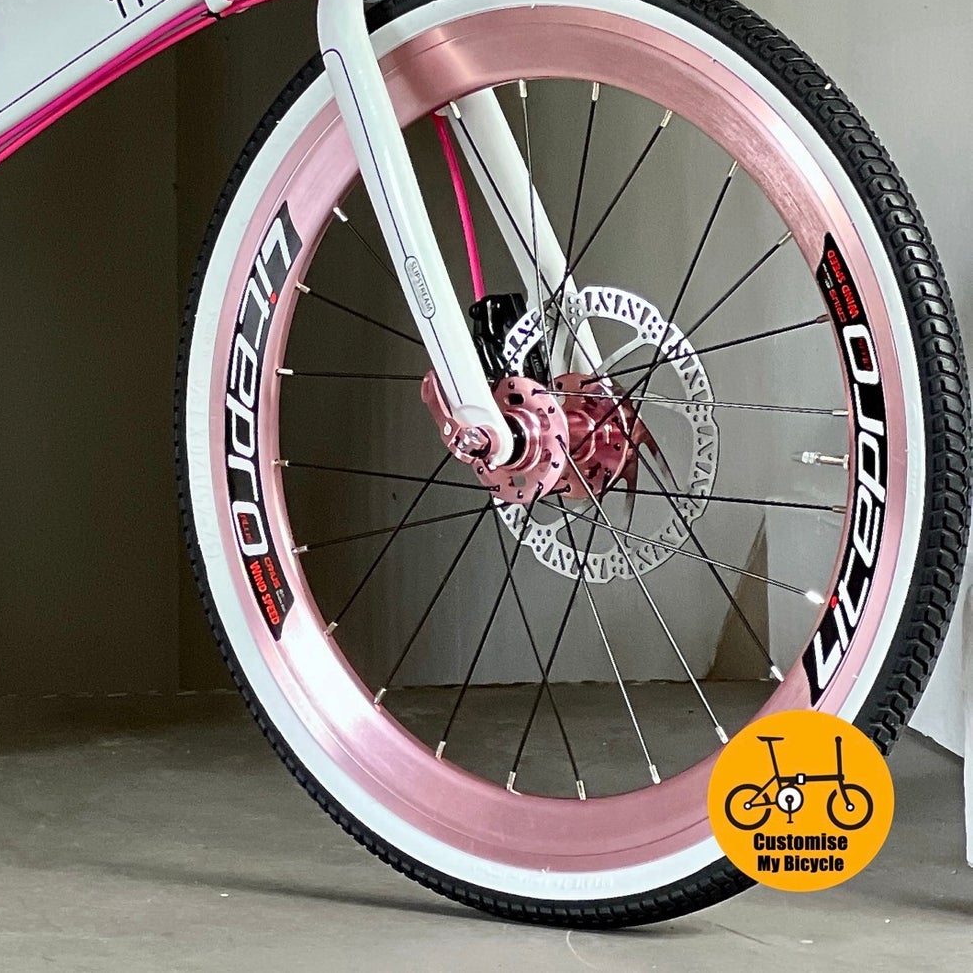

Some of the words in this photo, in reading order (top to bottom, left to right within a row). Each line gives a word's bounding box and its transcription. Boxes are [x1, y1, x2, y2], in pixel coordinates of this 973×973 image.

[410, 261, 433, 312] SLIPSTREAM
[827, 249, 846, 284] SPEED
[841, 284, 860, 319] WIND
[226, 217, 292, 556] Litepro
[812, 324, 886, 689] Litepro
[249, 560, 268, 593] WIND
[261, 593, 280, 626] SPEED
